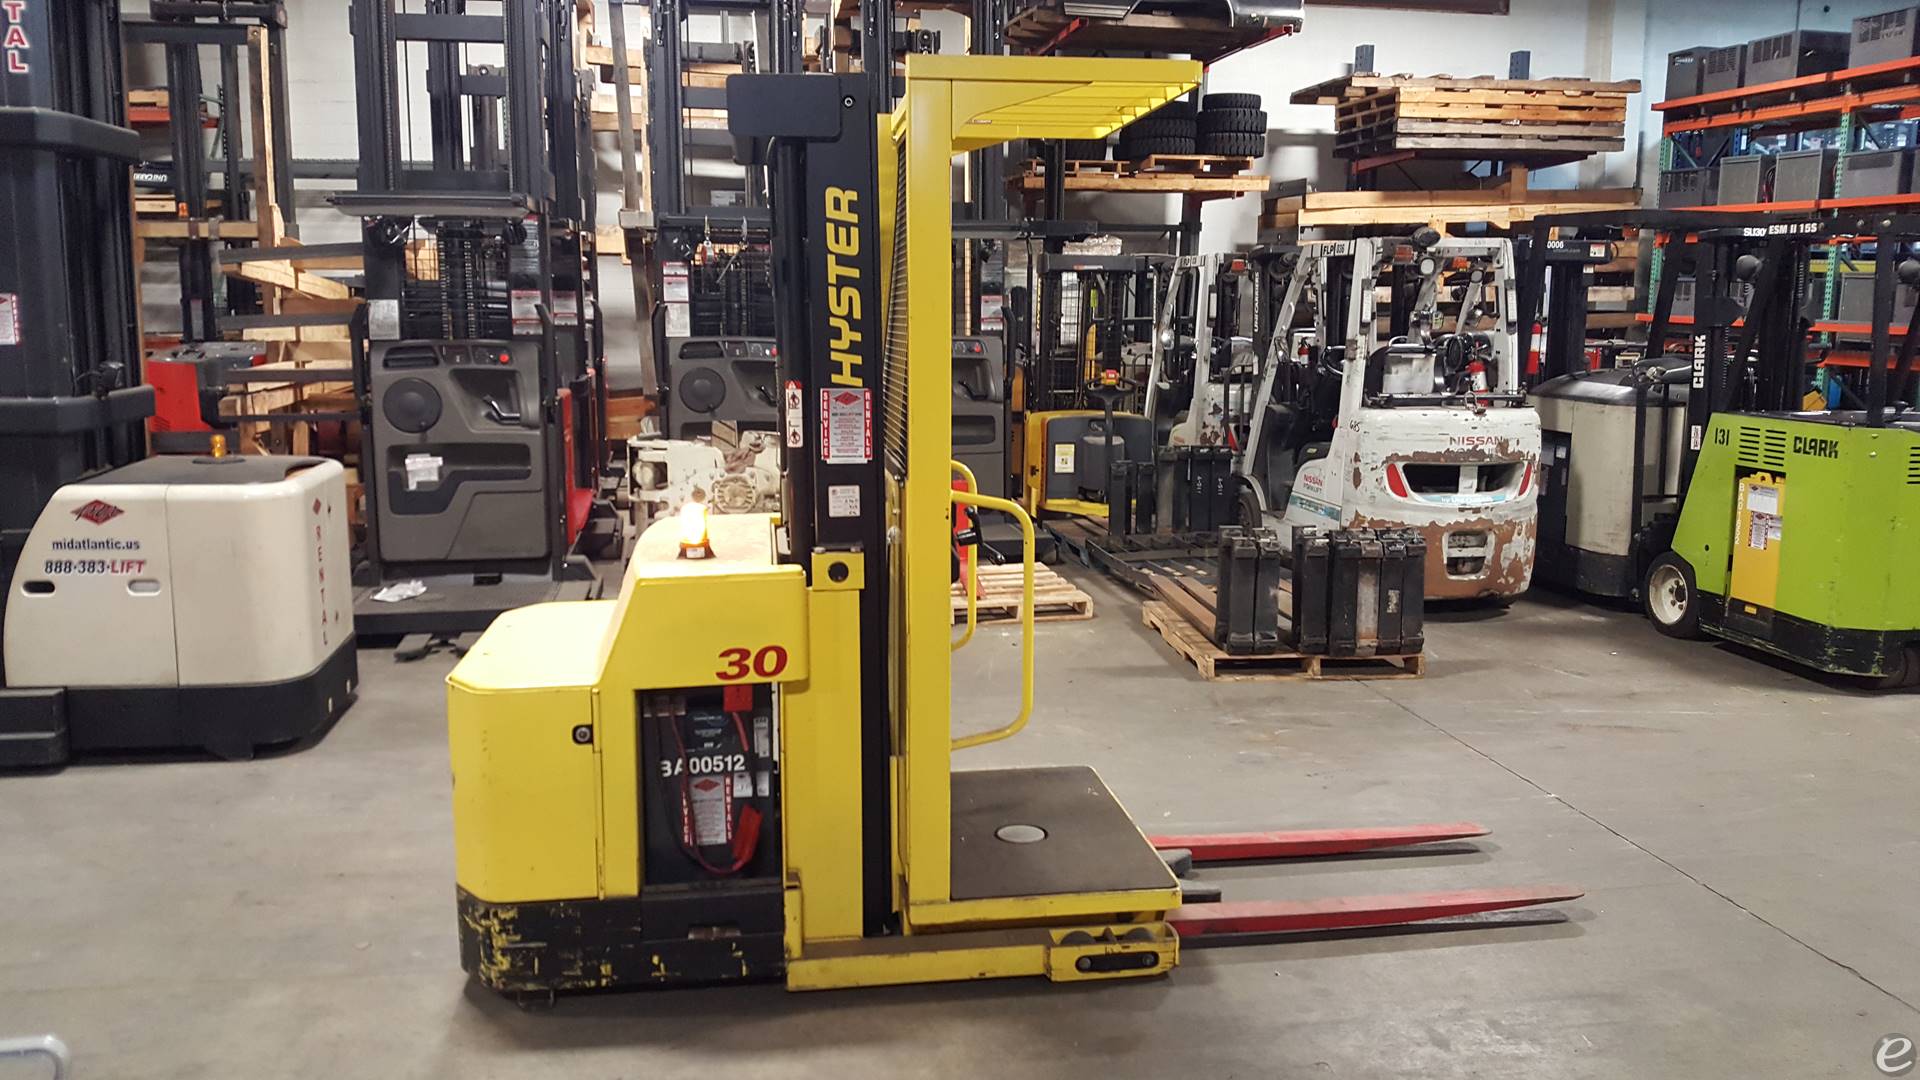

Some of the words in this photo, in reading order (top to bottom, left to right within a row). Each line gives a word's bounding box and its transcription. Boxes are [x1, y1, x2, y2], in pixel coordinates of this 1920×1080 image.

[1768, 224, 1787, 235] ESM
[1790, 223, 1798, 234] II
[824, 186, 864, 387] HYSTER
[1692, 334, 1706, 389] CLARK
[822, 391, 830, 457] SERVICE
[1449, 435, 1503, 446] NISSAN
[1793, 435, 1839, 459] CLARK
[52, 538, 141, 551] midatlantic.us
[715, 645, 788, 680] 30
